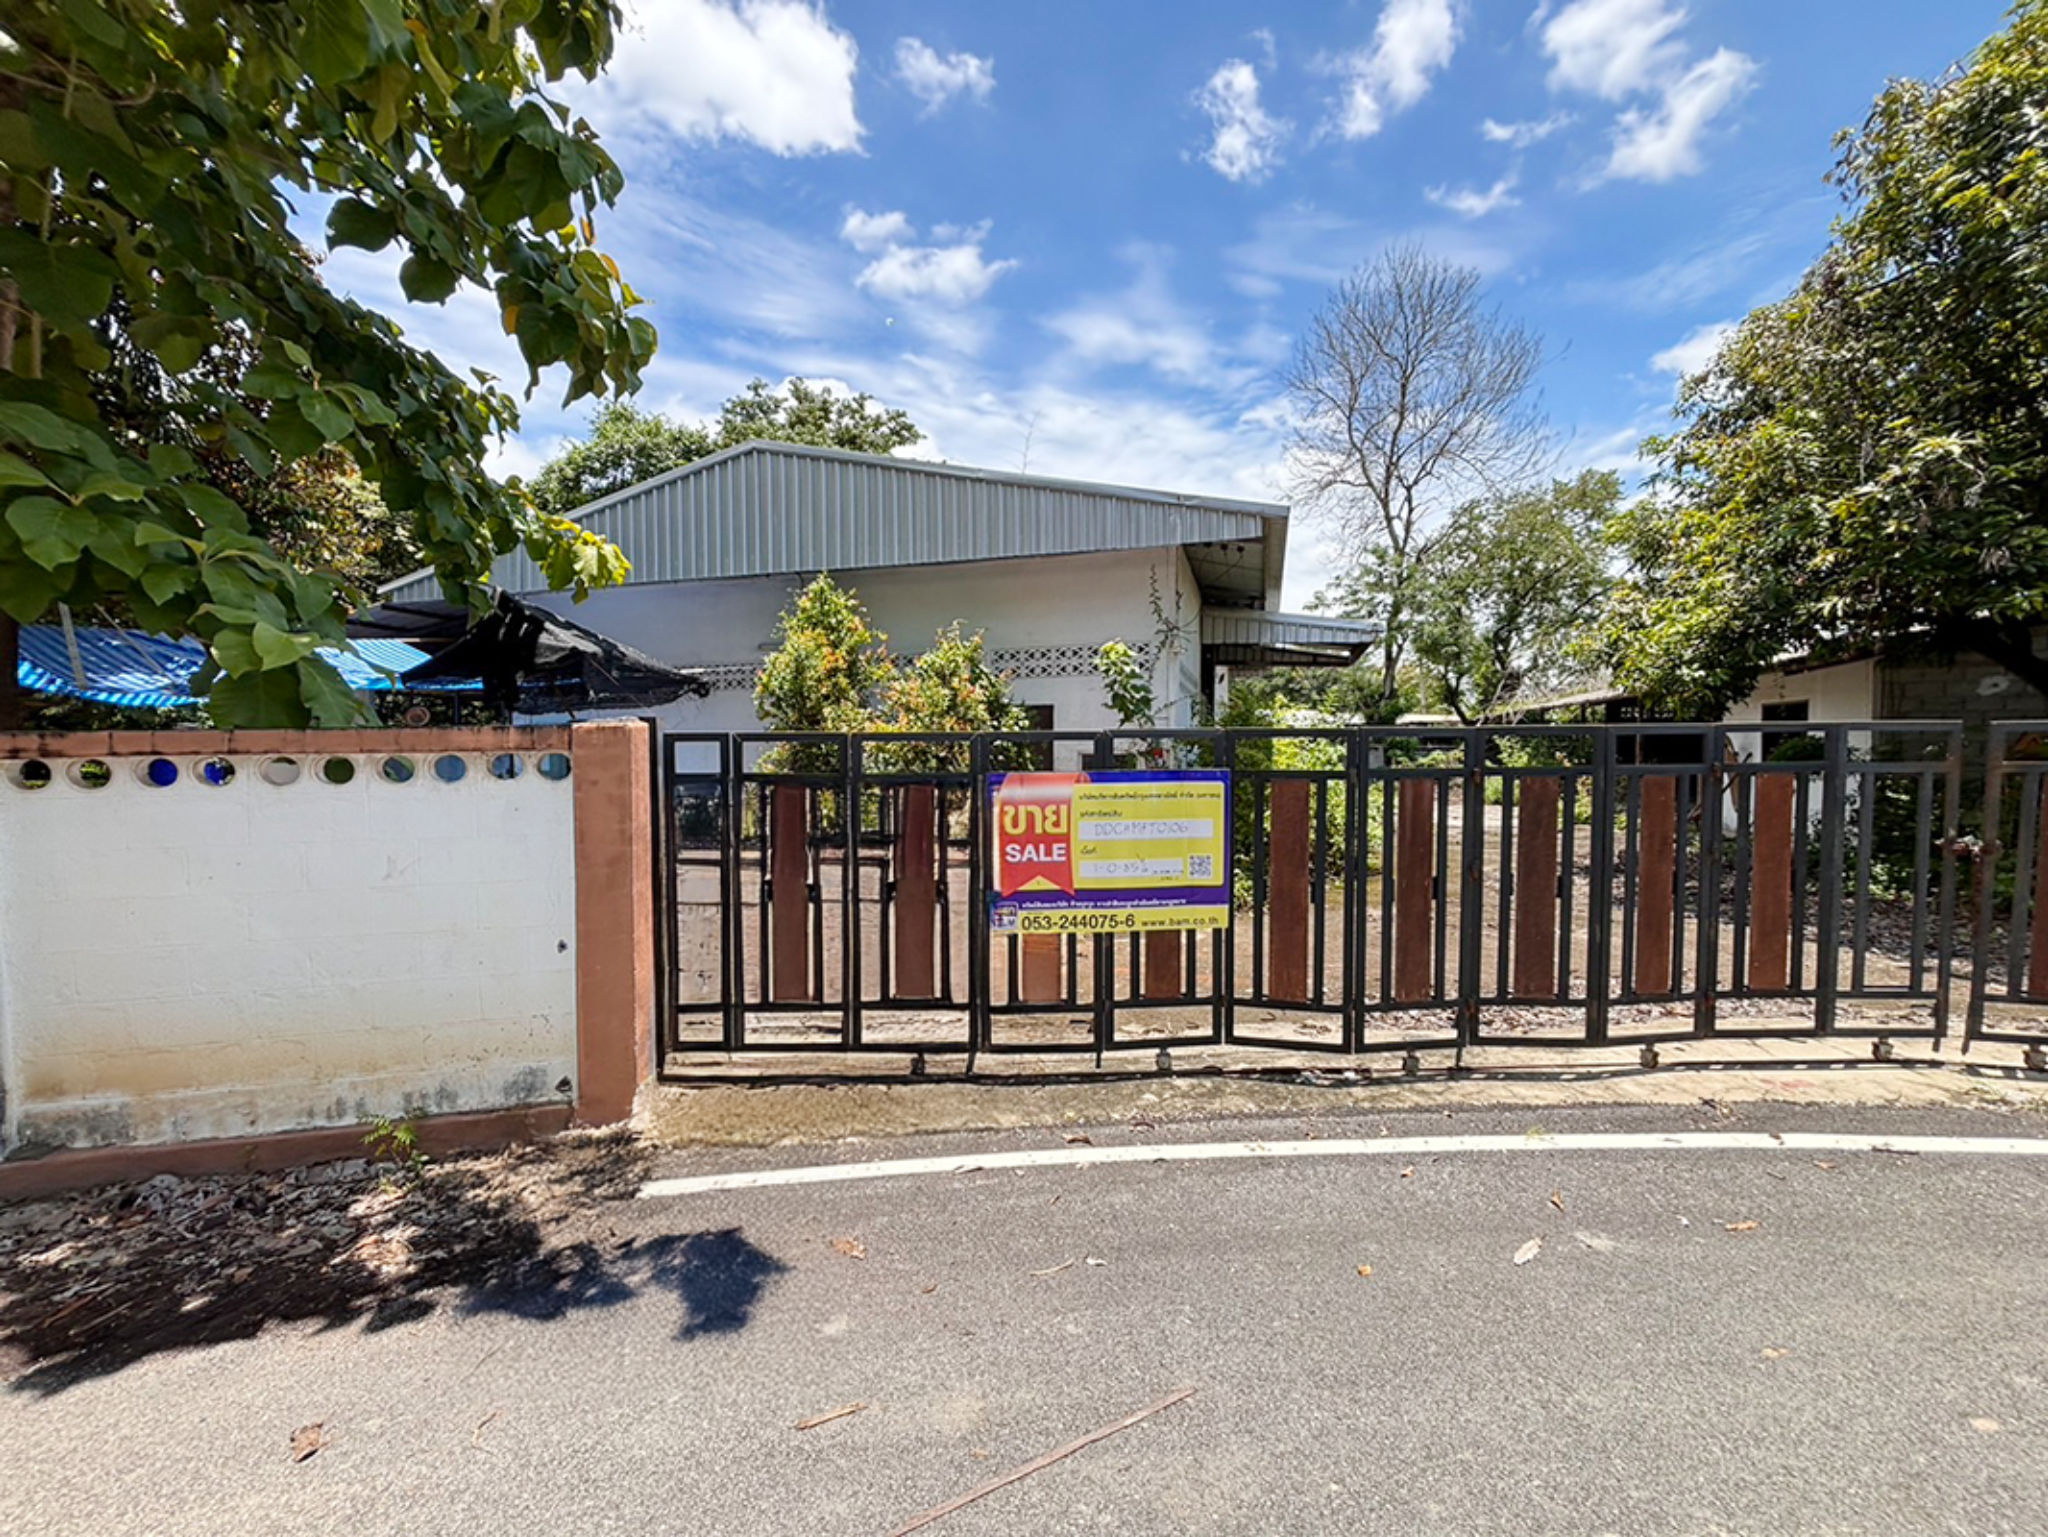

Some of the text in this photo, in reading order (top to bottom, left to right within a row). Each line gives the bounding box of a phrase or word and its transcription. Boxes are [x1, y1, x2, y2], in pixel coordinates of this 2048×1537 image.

[1003, 803, 1067, 835] ขาย
[1005, 843, 1067, 862] SALE
[1021, 914, 1135, 931] 053-244075-6
[1141, 917, 1219, 928] www.bam.co.th
